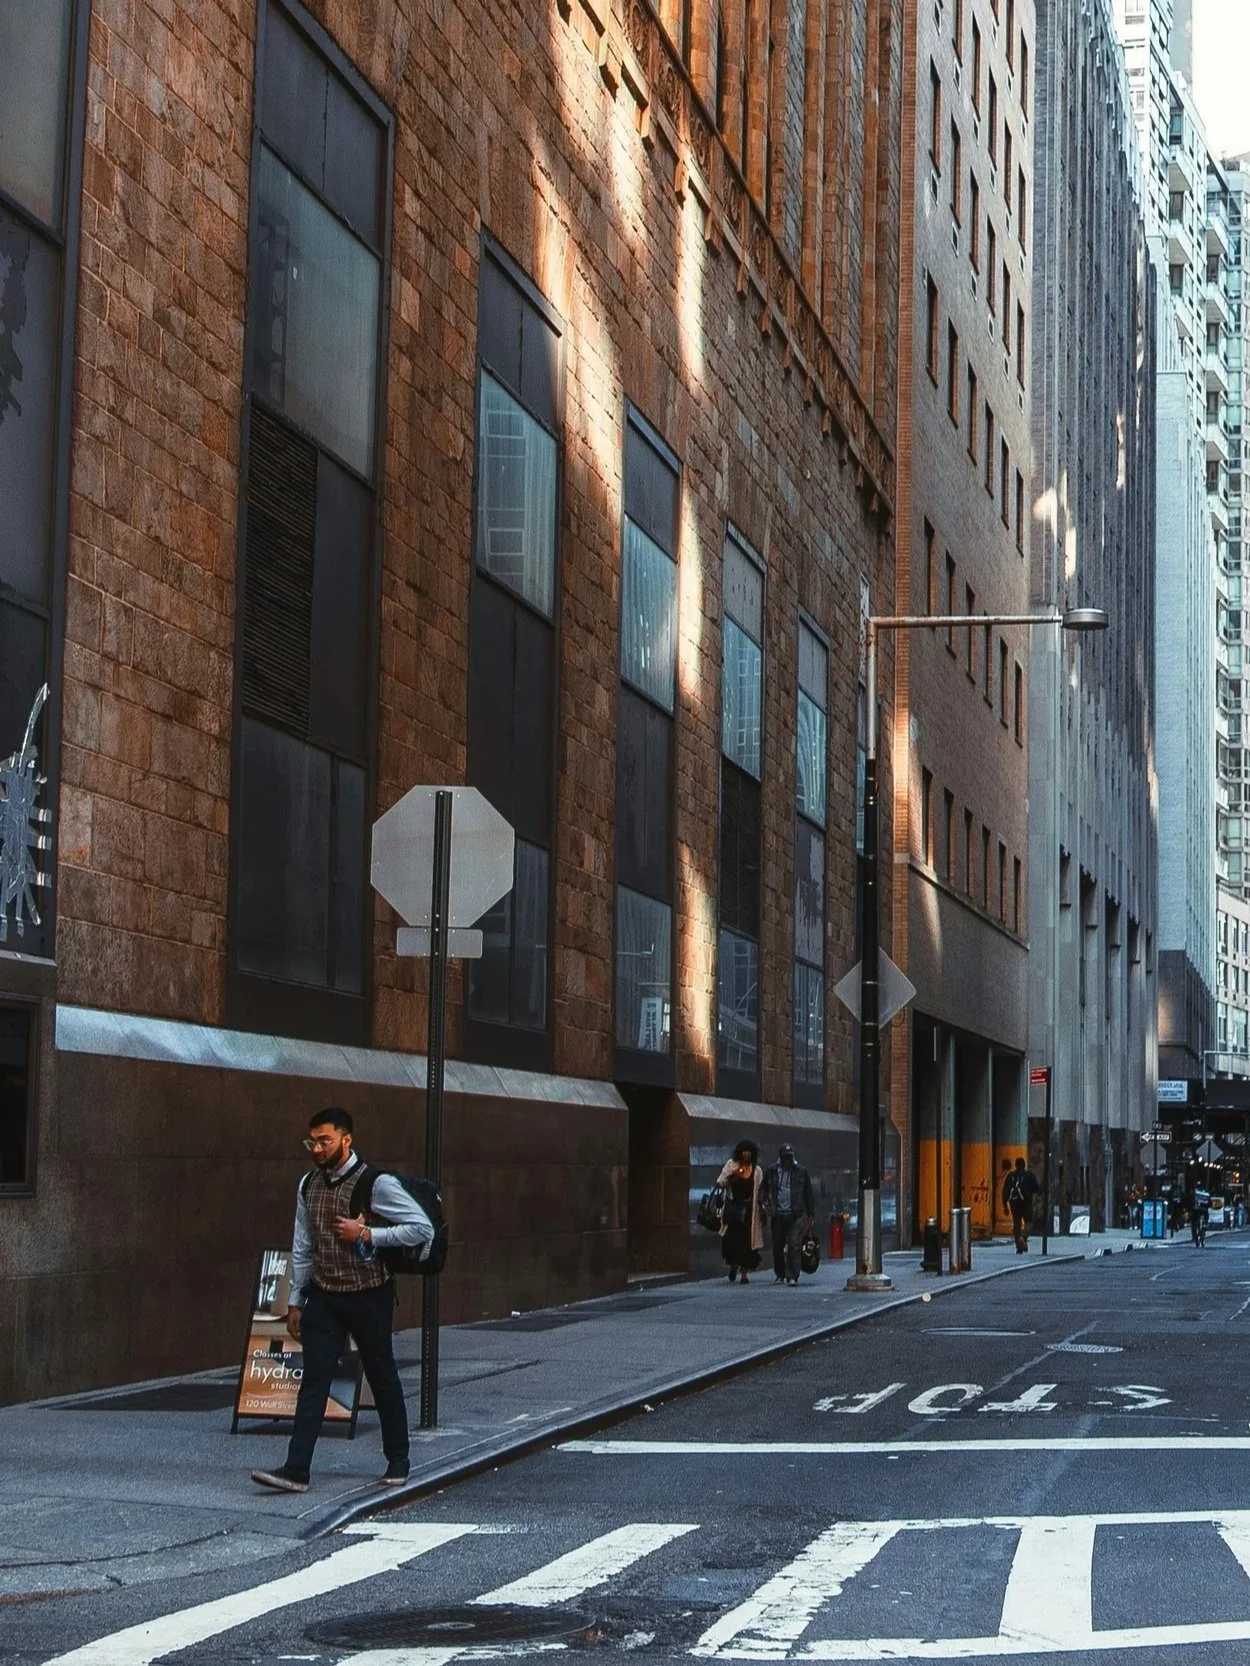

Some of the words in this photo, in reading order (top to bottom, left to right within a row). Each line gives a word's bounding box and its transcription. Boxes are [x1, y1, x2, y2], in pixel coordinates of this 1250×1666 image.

[253, 1348, 282, 1359] Classes
[250, 1360, 304, 1384] hydra
[246, 1399, 260, 1408] 120
[260, 1399, 277, 1409] Wall
[277, 1400, 297, 1410] Stree
